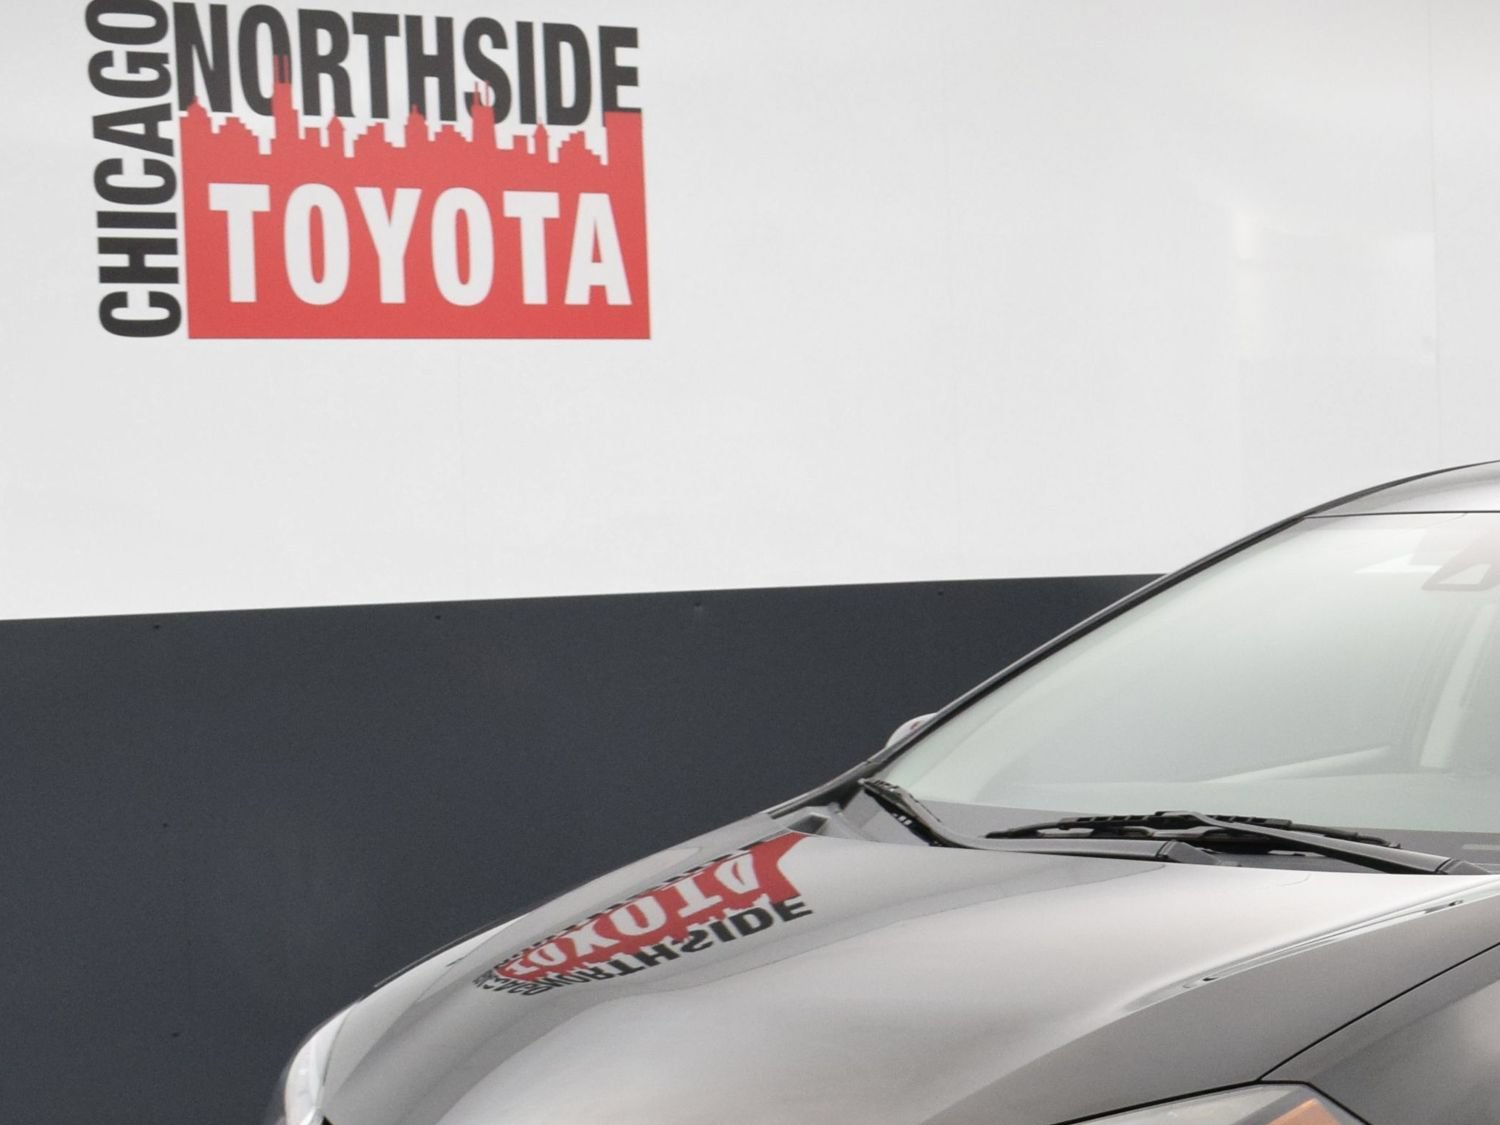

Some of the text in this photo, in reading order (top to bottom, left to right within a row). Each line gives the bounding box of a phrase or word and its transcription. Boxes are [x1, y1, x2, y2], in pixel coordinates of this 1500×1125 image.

[172, 1, 642, 126] NORTHSIDE
[85, 0, 182, 338] CHICAGO
[208, 183, 632, 306] TOYOTA
